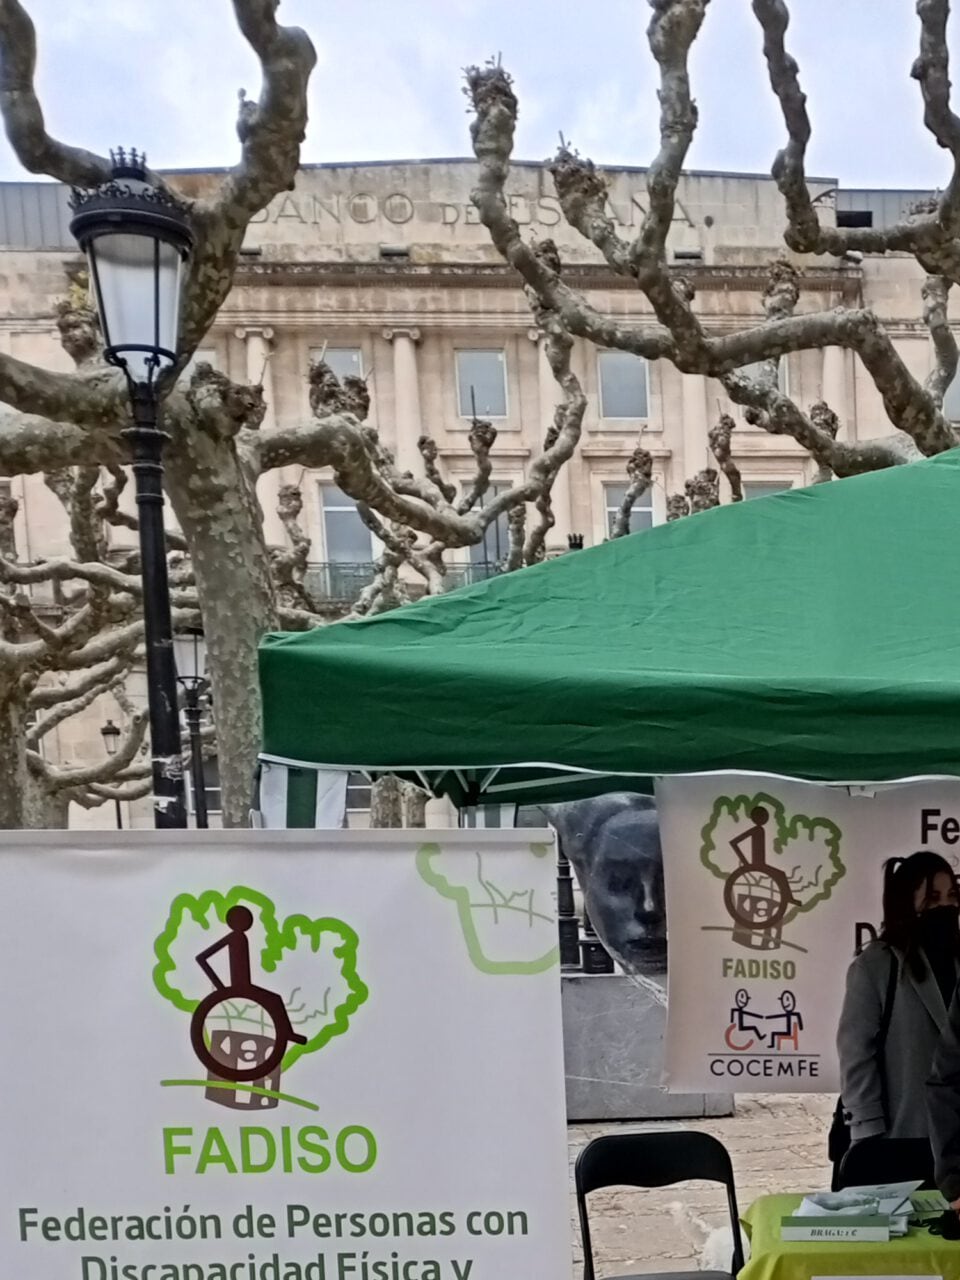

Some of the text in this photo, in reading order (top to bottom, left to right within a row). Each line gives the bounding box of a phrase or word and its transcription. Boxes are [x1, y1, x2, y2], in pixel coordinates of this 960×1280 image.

[722, 958, 797, 980] FADISO
[710, 1059, 820, 1077] COCEMFE
[162, 1125, 378, 1175] FADISO
[18, 1204, 529, 1241] Federación de Personas con
